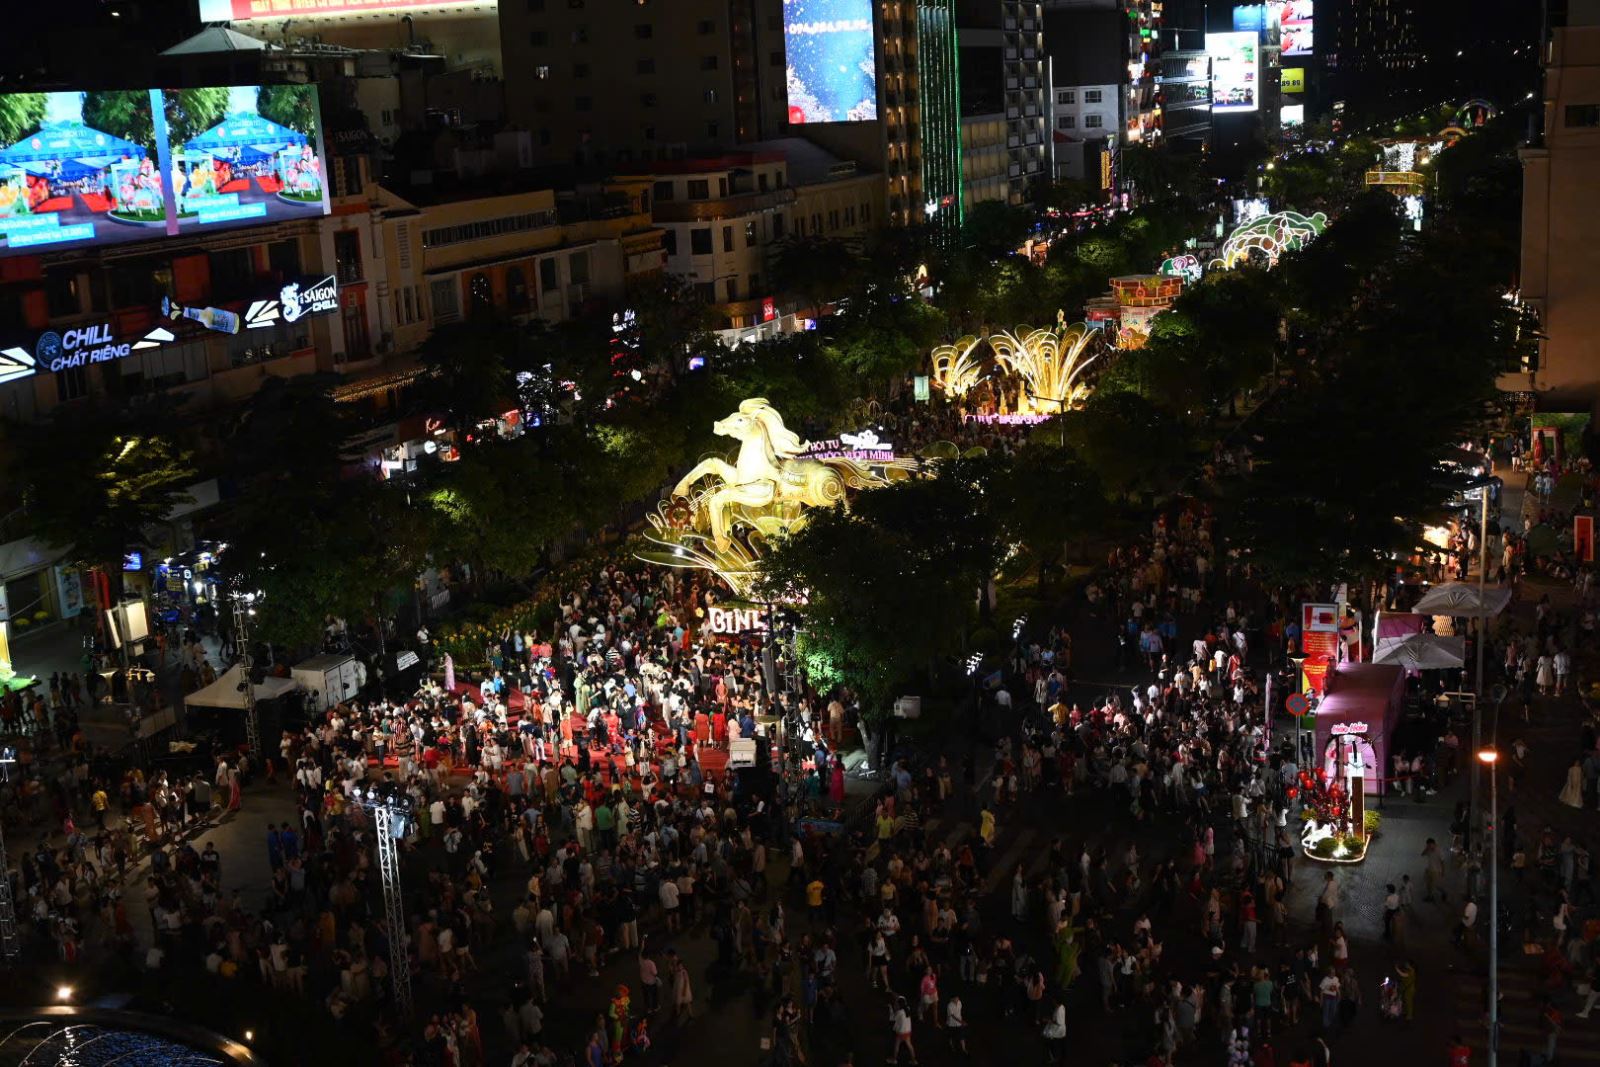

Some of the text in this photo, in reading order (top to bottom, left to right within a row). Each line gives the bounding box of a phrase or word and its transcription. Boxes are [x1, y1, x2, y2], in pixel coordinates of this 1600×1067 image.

[304, 287, 336, 303] SAIGON
[62, 323, 113, 350] CHILL
[50, 343, 131, 372] CHẤT RIÊNG
